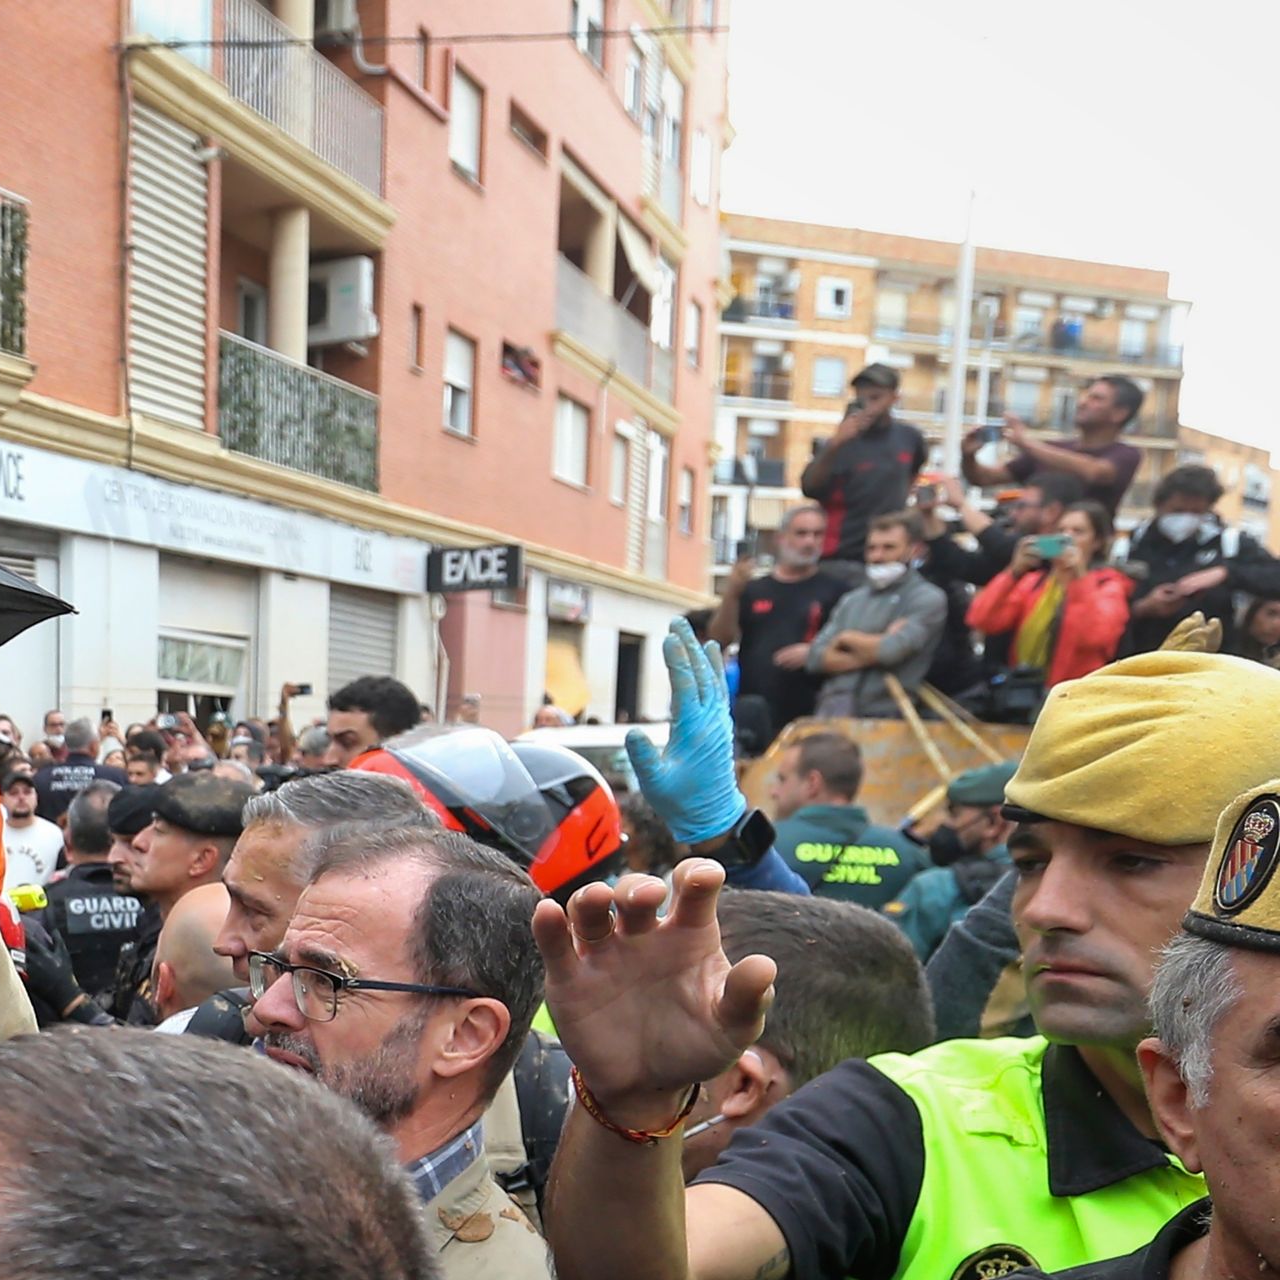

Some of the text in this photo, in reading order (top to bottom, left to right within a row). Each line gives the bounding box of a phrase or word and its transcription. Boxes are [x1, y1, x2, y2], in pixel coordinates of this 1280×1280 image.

[104, 479, 149, 511] CENTRO
[151, 490, 168, 513] DE
[69, 896, 145, 915] GUARD
